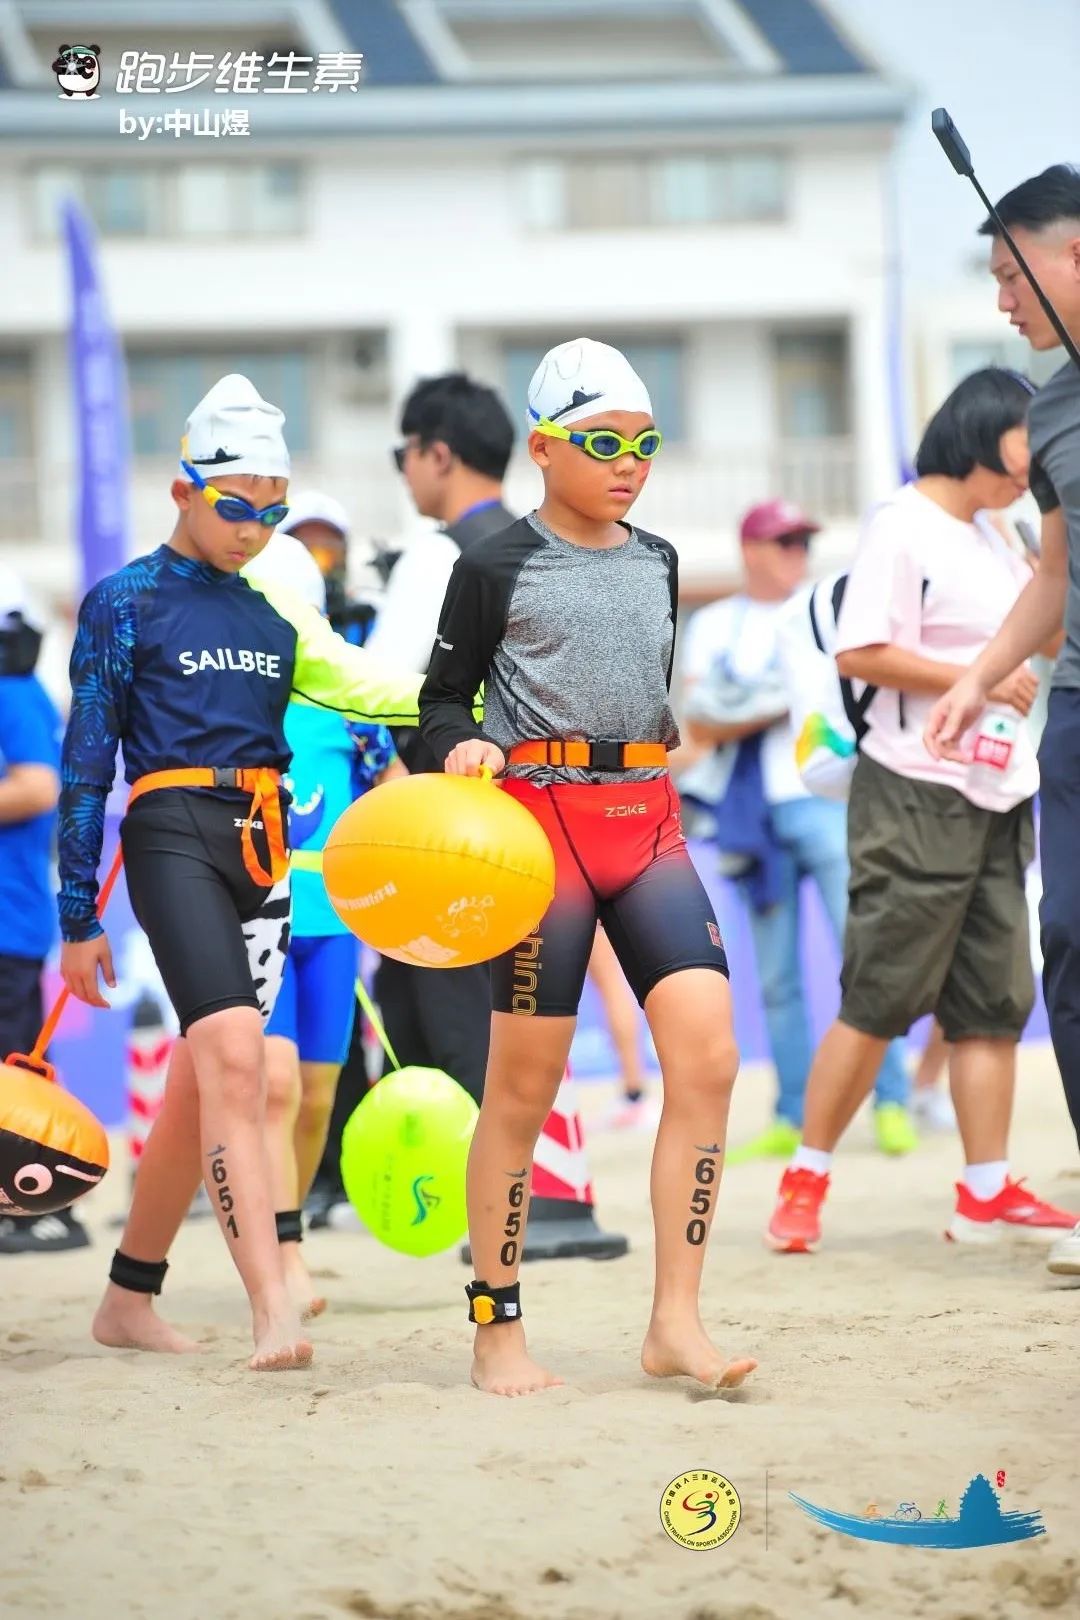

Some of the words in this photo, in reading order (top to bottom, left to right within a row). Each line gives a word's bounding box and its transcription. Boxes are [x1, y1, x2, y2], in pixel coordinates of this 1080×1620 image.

[178, 648, 281, 679] SAILBEE
[512, 922, 544, 1016] hina
[211, 1158, 240, 1239] 651
[500, 1182, 524, 1267] 650
[685, 1157, 716, 1246] 650
